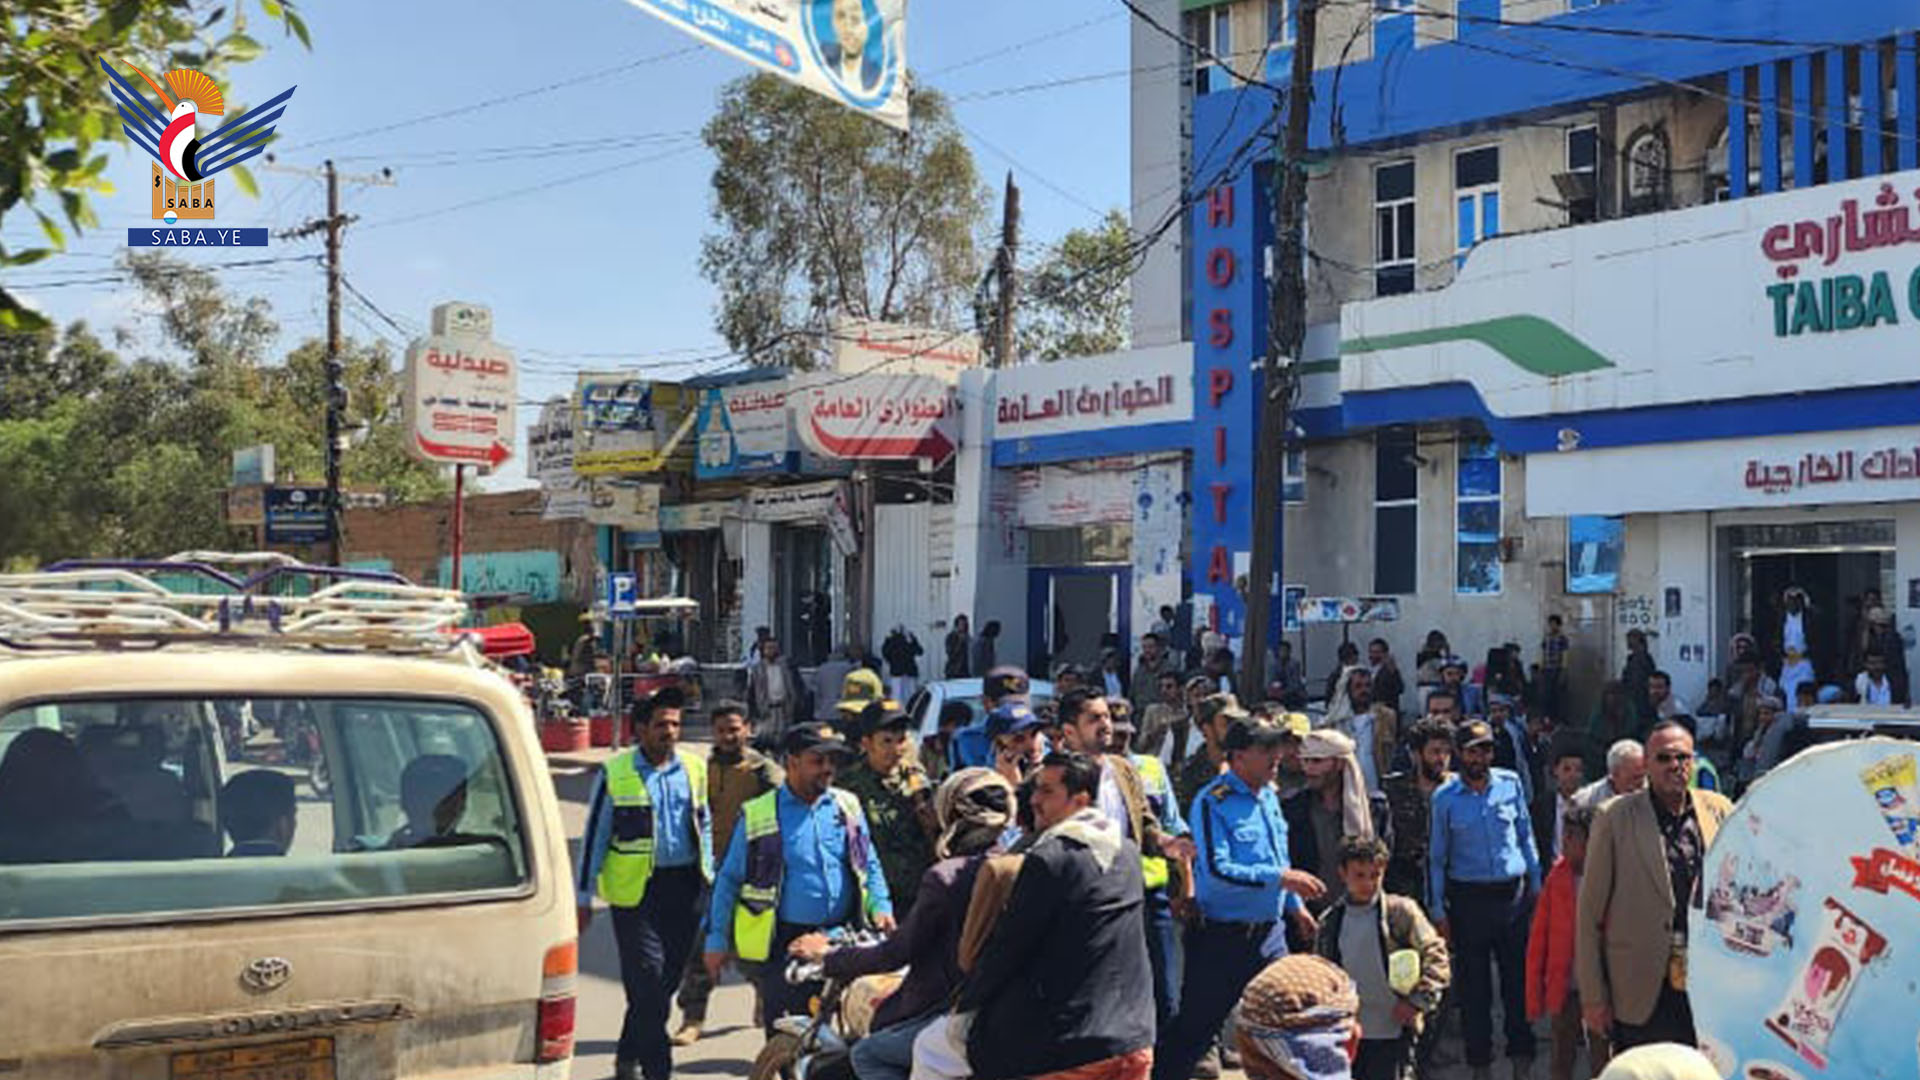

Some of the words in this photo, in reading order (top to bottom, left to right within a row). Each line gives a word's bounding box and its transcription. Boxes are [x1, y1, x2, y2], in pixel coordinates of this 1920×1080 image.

[1765, 262, 1899, 338] TAIBA
[426, 346, 510, 380] صيدلية
[814, 389, 871, 419] العامة
[996, 388, 1074, 424] العامة
[1745, 449, 1854, 494] الخارجية
[611, 575, 632, 605] P
